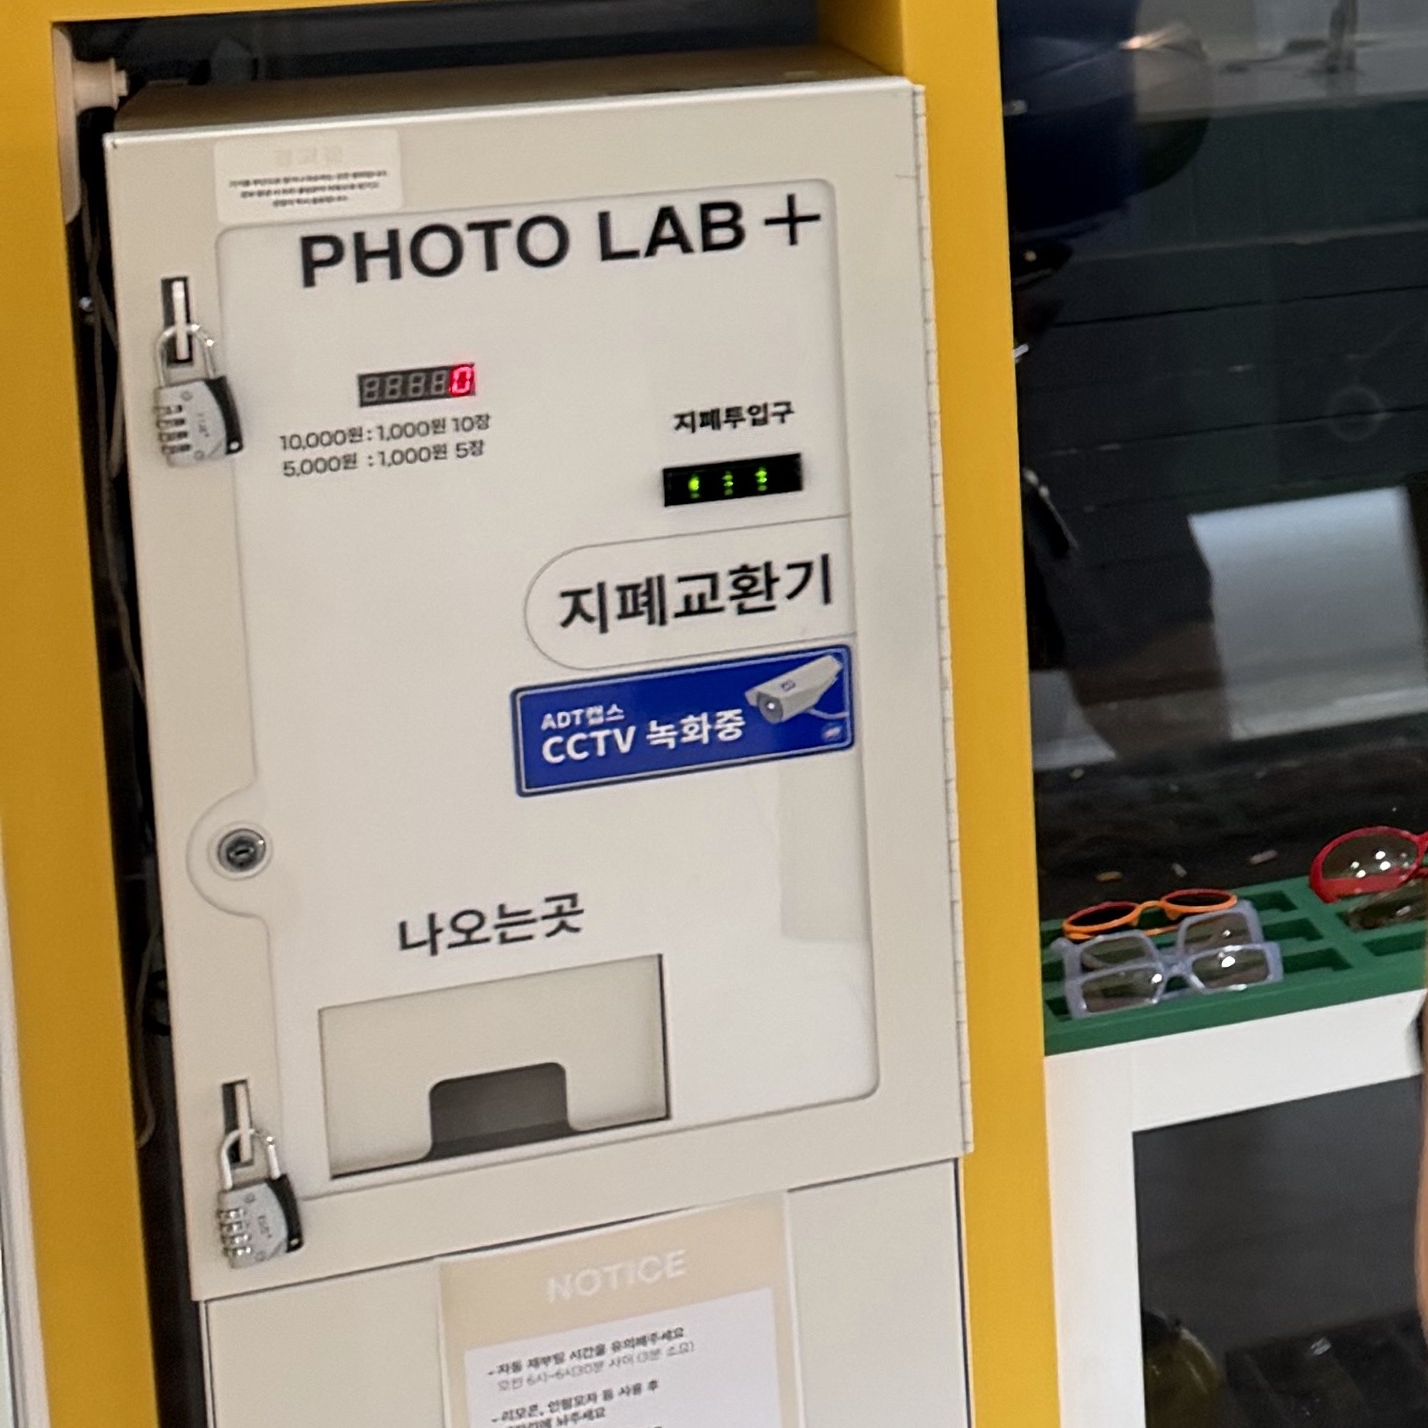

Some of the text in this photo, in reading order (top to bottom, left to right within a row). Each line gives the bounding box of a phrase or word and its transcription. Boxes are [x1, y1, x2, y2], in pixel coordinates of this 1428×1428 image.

[300, 215, 570, 288] PHOTO
[598, 200, 746, 261] LAB
[452, 413, 491, 433] 10장
[456, 439, 485, 459] 5장
[560, 553, 832, 634] 지폐교환기
[541, 703, 625, 731] ADT캡스
[541, 708, 747, 764] CCTV 녹화중
[399, 892, 584, 957] 나오는곳
[548, 1249, 687, 1303] NOTICE
